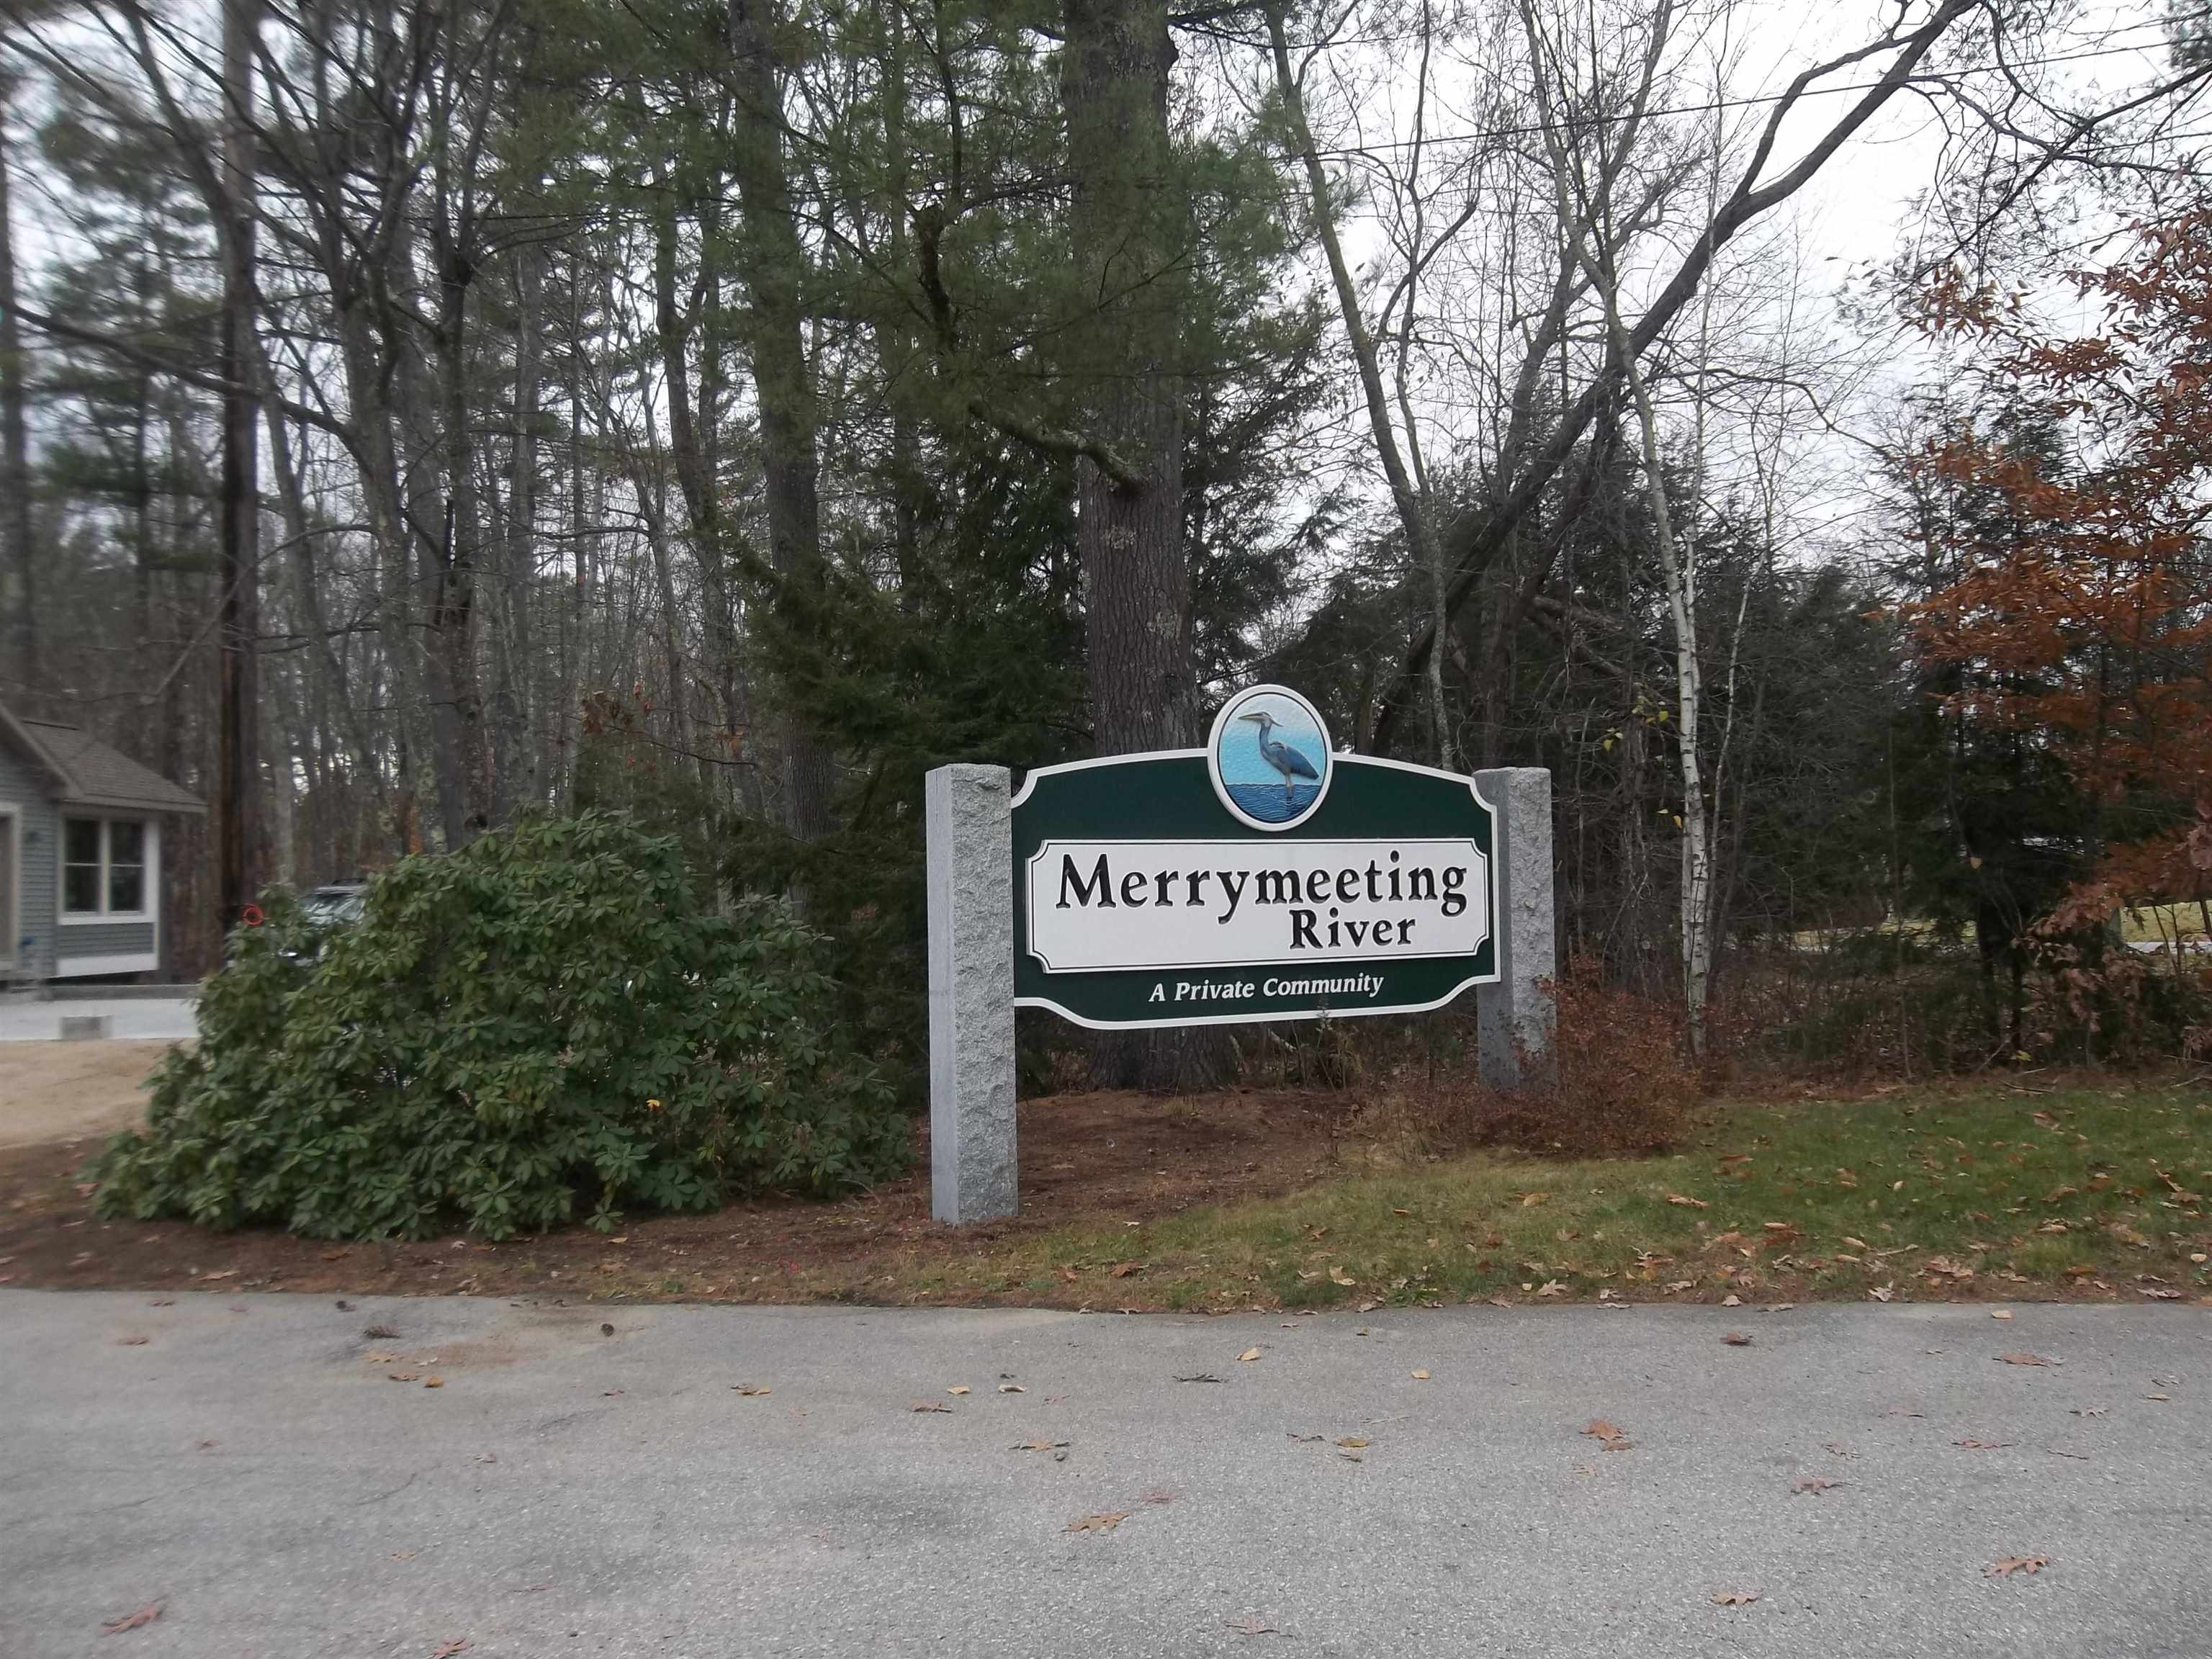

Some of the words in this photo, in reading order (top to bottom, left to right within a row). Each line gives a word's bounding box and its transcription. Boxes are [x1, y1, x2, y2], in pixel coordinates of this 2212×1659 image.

[1055, 850, 1468, 925] Merrymeeting
[1288, 907, 1416, 950] River
[1148, 983, 1166, 1002] A
[1174, 979, 1255, 1001] Private
[1263, 974, 1384, 998] Community
